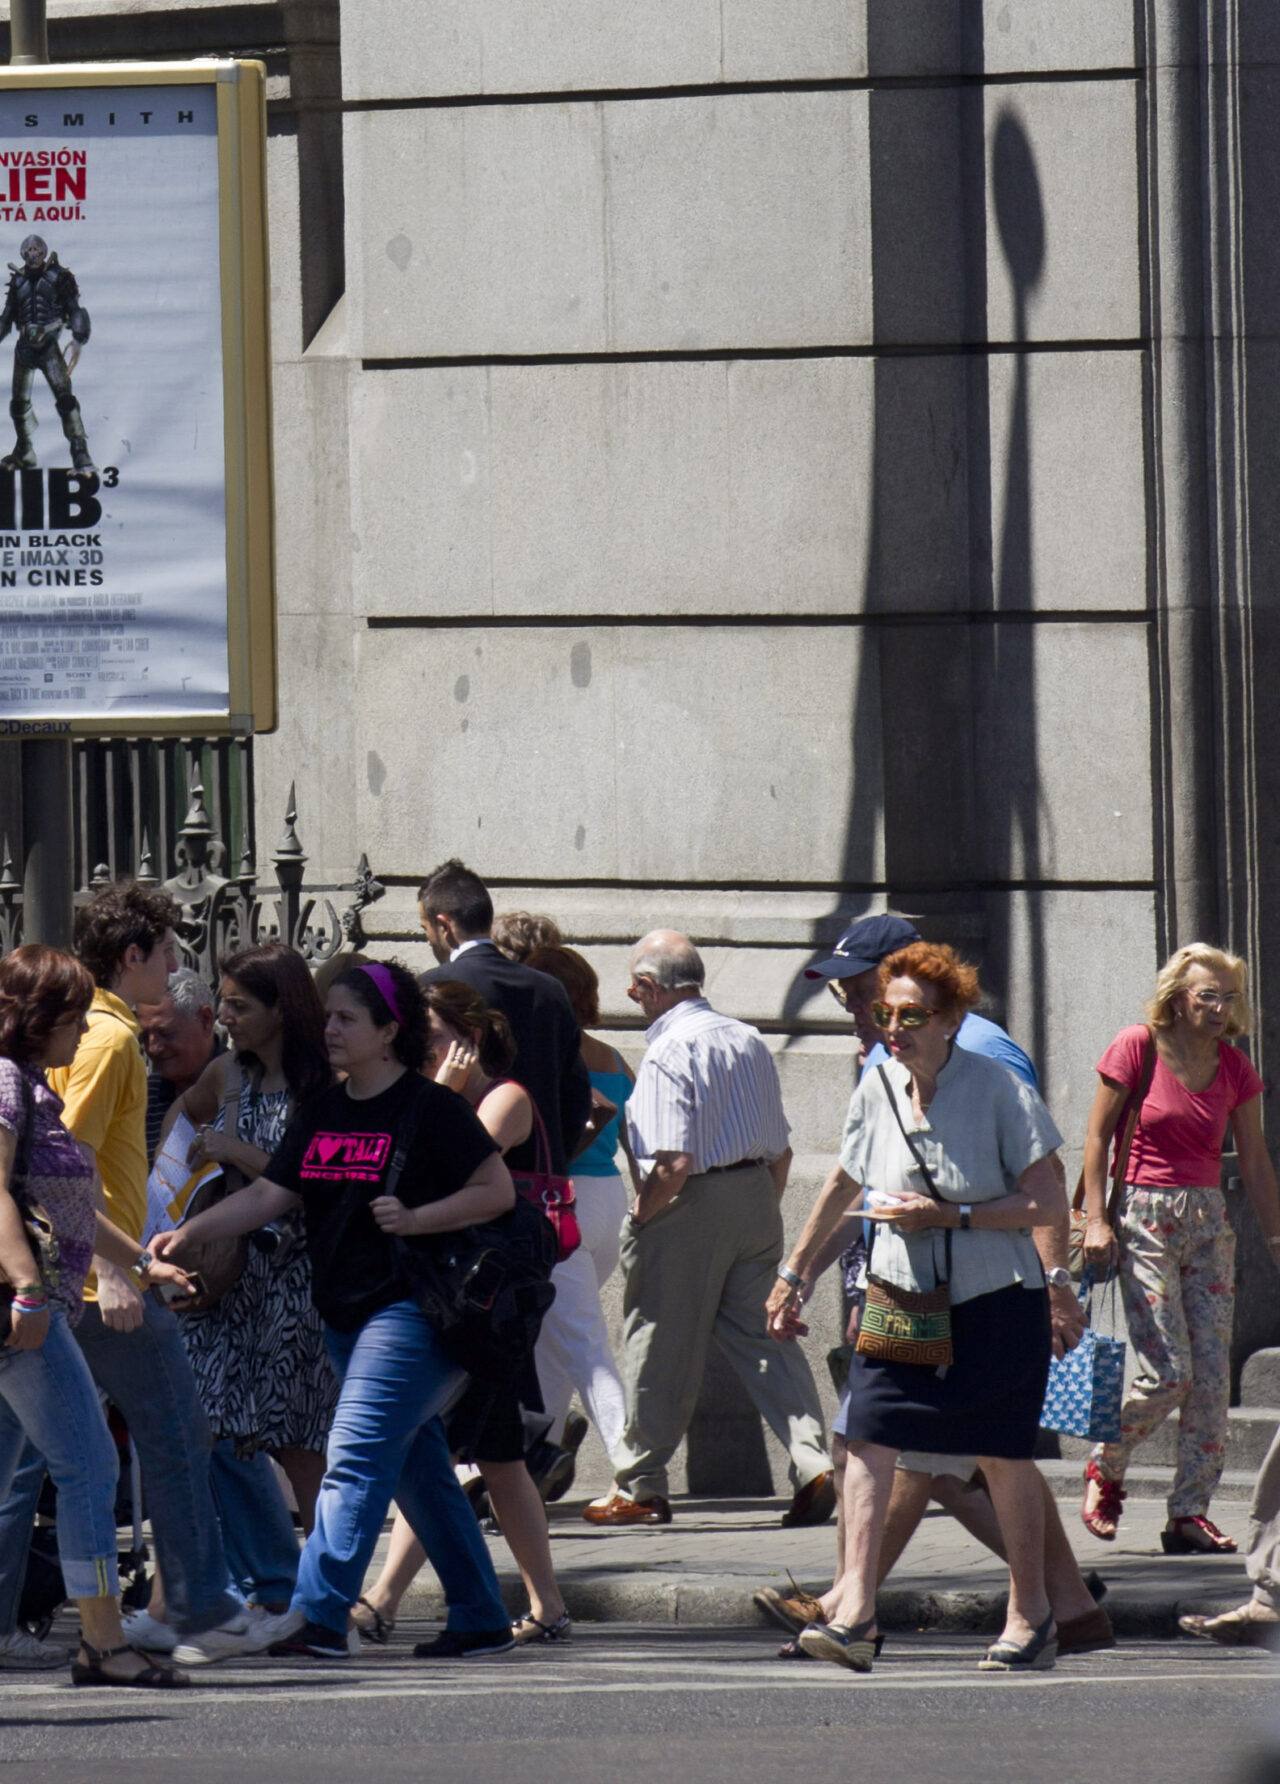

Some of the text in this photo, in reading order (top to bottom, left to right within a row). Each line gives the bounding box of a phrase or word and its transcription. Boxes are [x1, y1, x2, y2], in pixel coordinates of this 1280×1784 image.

[23, 110, 194, 128] SMITH
[32, 204, 87, 222] AQUÍ.
[28, 534, 102, 548] BLACK
[3, 550, 14, 567] E
[20, 549, 69, 566] IMAX
[79, 549, 103, 566] 3D
[27, 569, 104, 587] CINES
